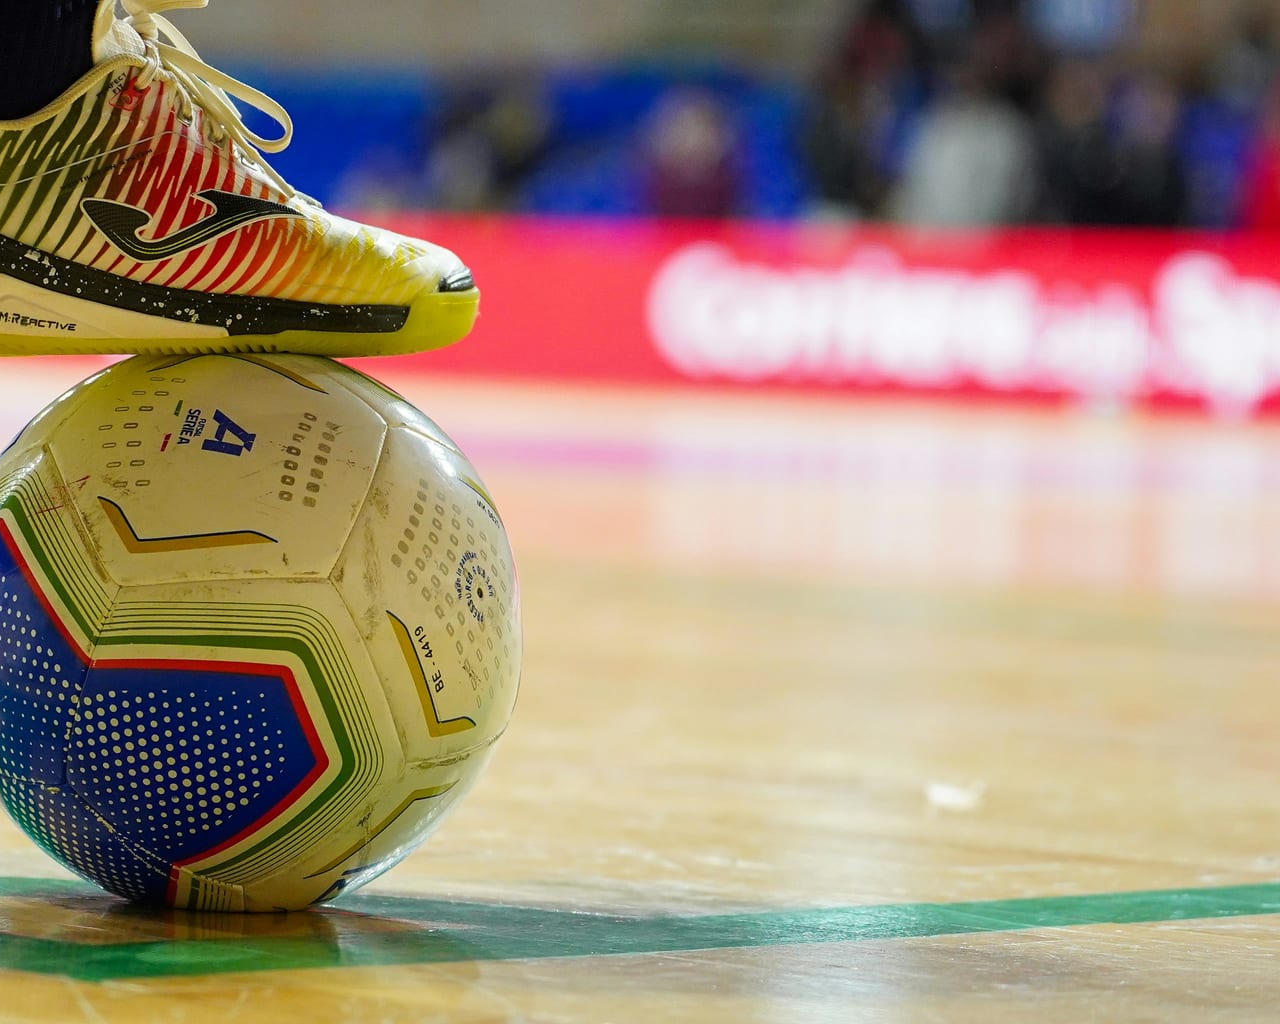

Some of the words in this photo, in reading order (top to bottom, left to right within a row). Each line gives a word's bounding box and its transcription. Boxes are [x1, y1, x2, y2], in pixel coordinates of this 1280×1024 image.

[180, 408, 201, 437] SERIE
[177, 436, 190, 445] A
[414, 626, 433, 658] 4419
[431, 669, 444, 693] BE
